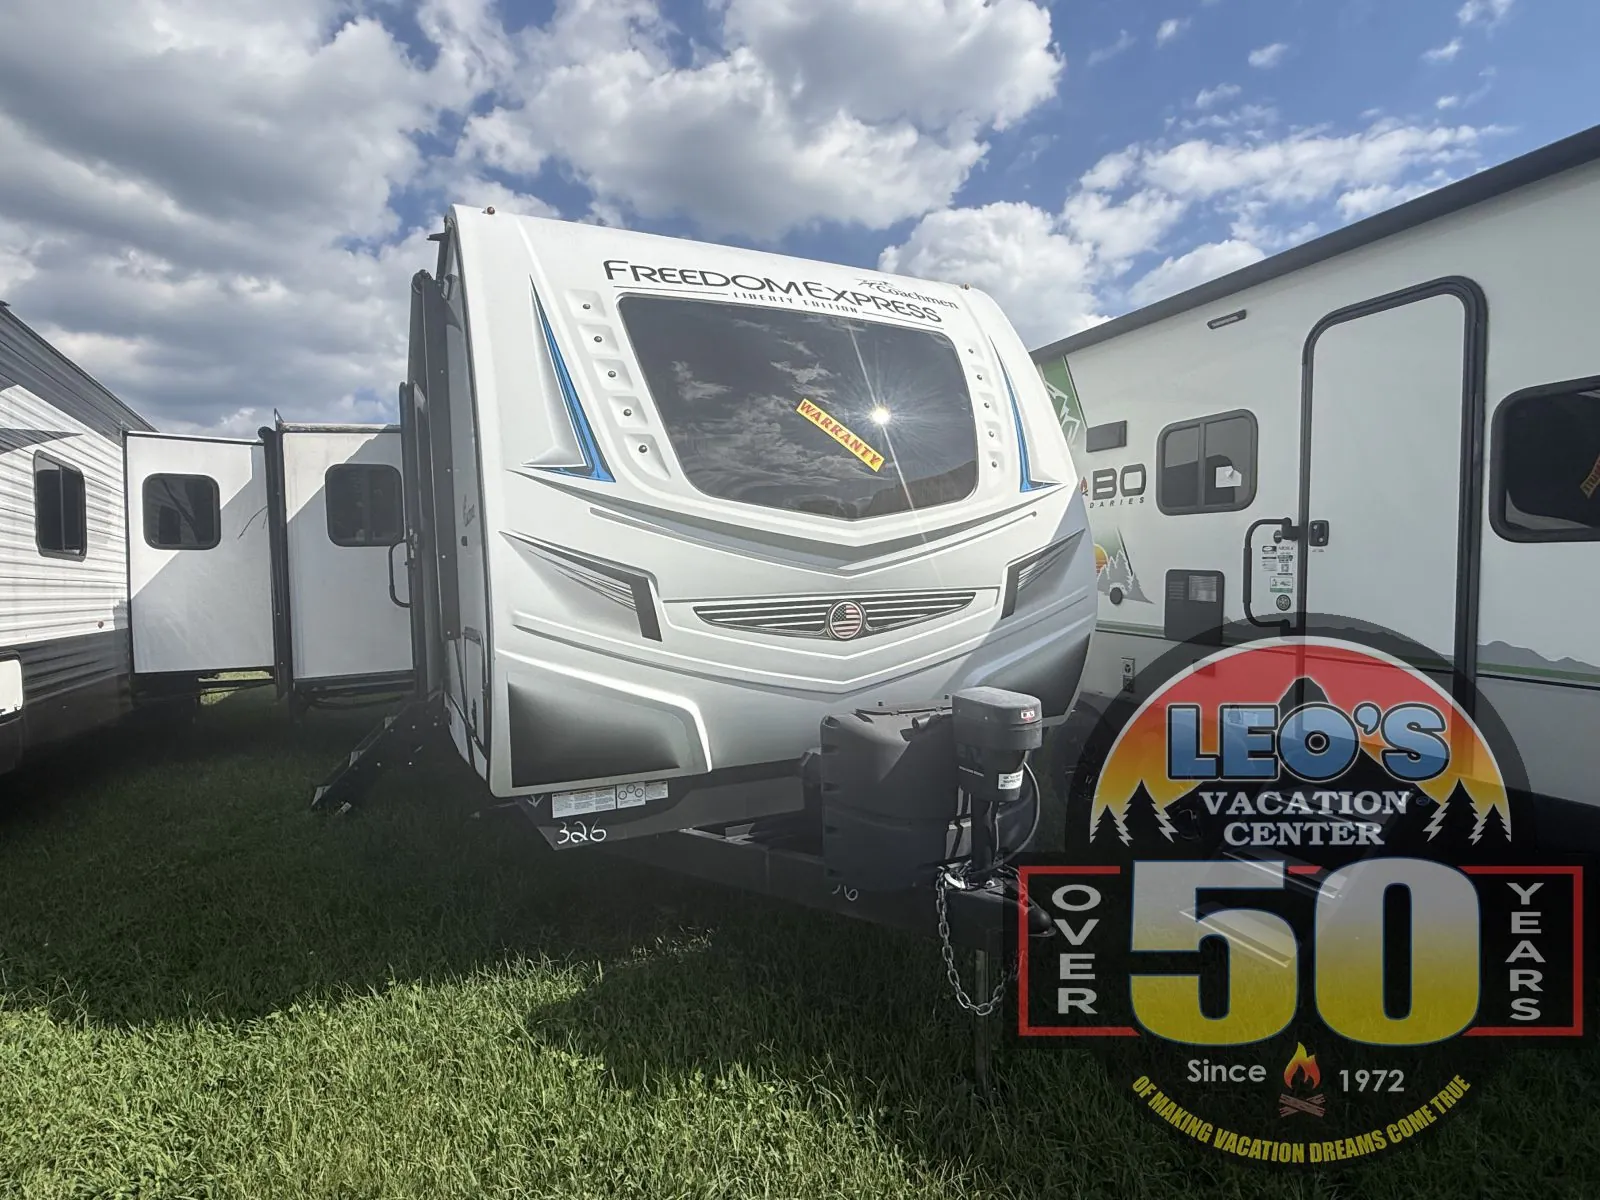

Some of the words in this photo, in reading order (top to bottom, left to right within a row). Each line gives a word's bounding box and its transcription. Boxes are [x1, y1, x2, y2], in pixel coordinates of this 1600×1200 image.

[877, 284, 959, 310] Coachmen
[801, 401, 881, 468] WARRANTY
[557, 819, 607, 845] 326
